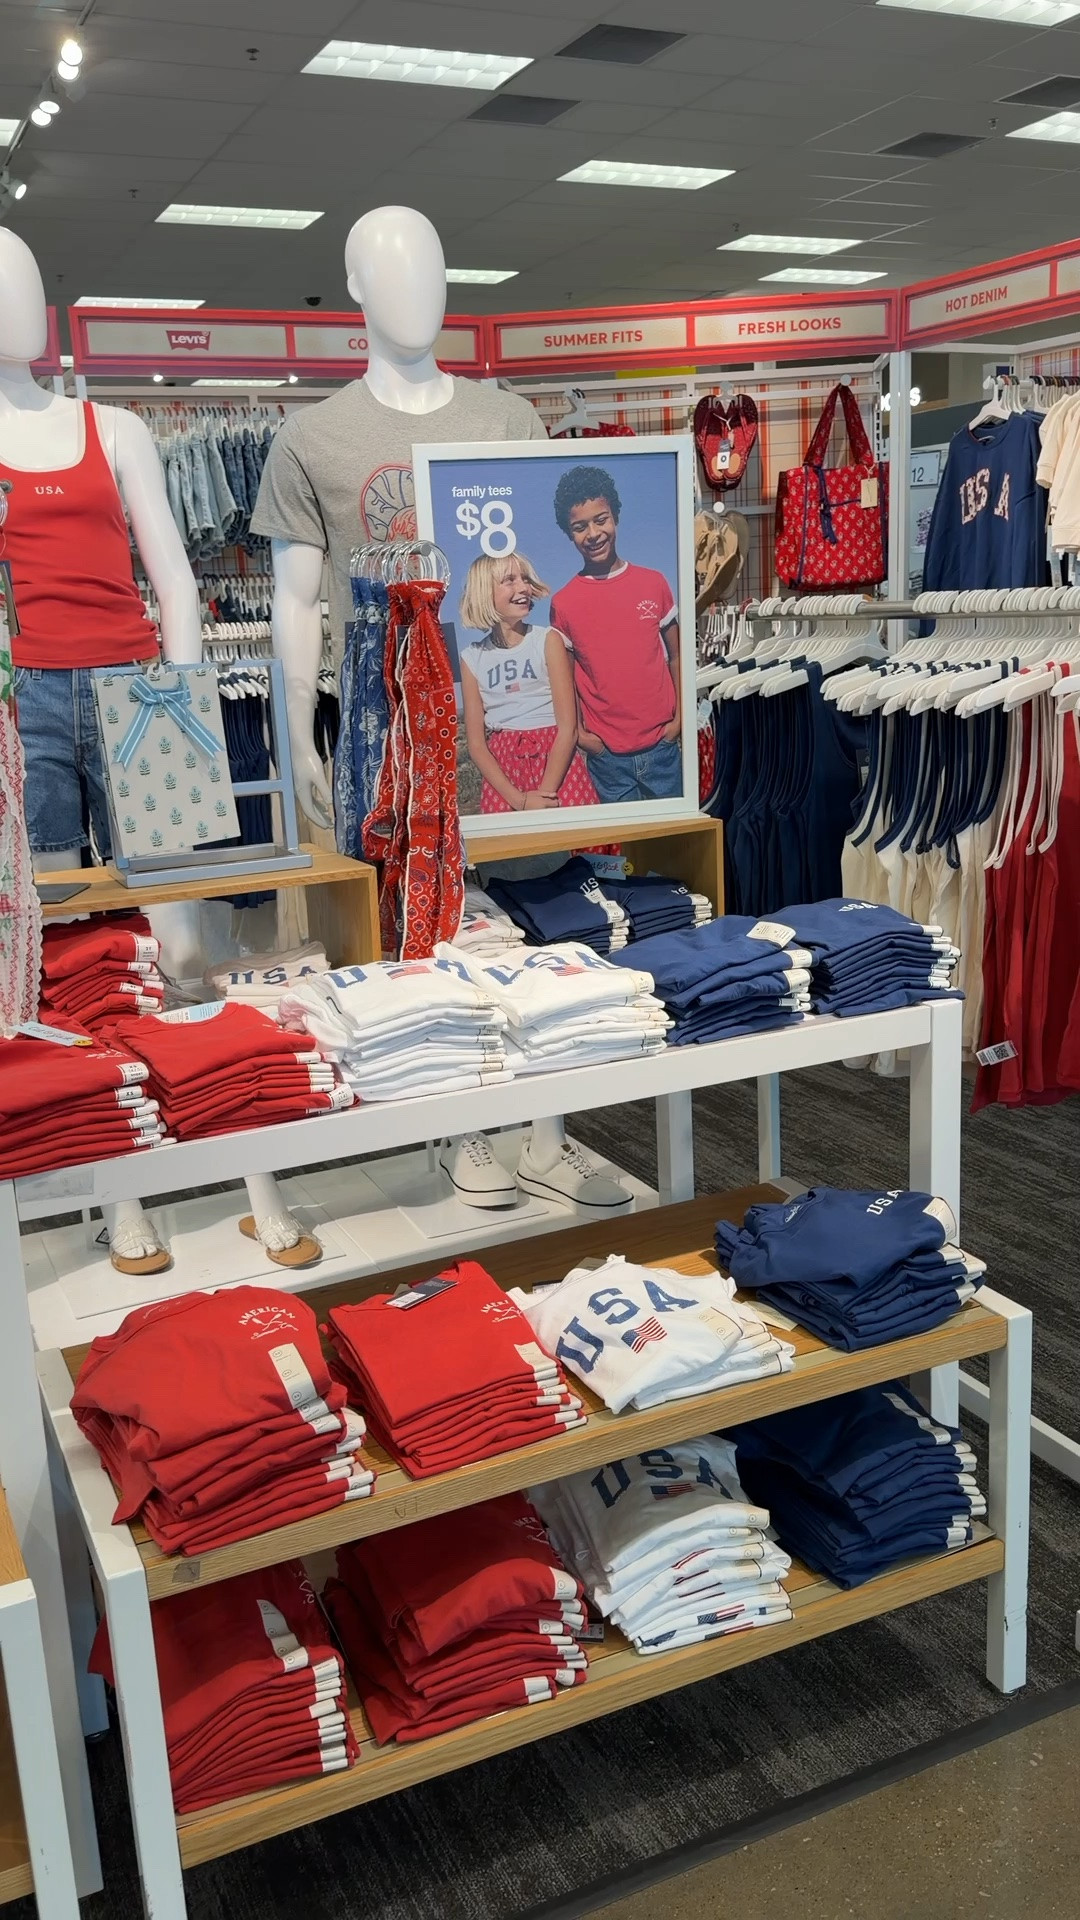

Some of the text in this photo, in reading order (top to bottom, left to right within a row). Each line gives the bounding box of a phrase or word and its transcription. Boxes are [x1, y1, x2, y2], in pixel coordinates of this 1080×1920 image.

[945, 286, 1009, 313] HOT DENIM
[543, 330, 644, 348] SUMMER FITS
[737, 317, 842, 335] FRESH LOOKS
[34, 485, 65, 495] USA
[452, 485, 513, 499] family tees
[958, 467, 1010, 525] USA
[455, 499, 517, 559] $8
[487, 658, 538, 689] USA
[579, 877, 600, 896] US
[866, 1189, 904, 1216] USA
[238, 1305, 296, 1326] AMERICAN
[555, 1279, 700, 1374] USA
[590, 1448, 734, 1509] USA
